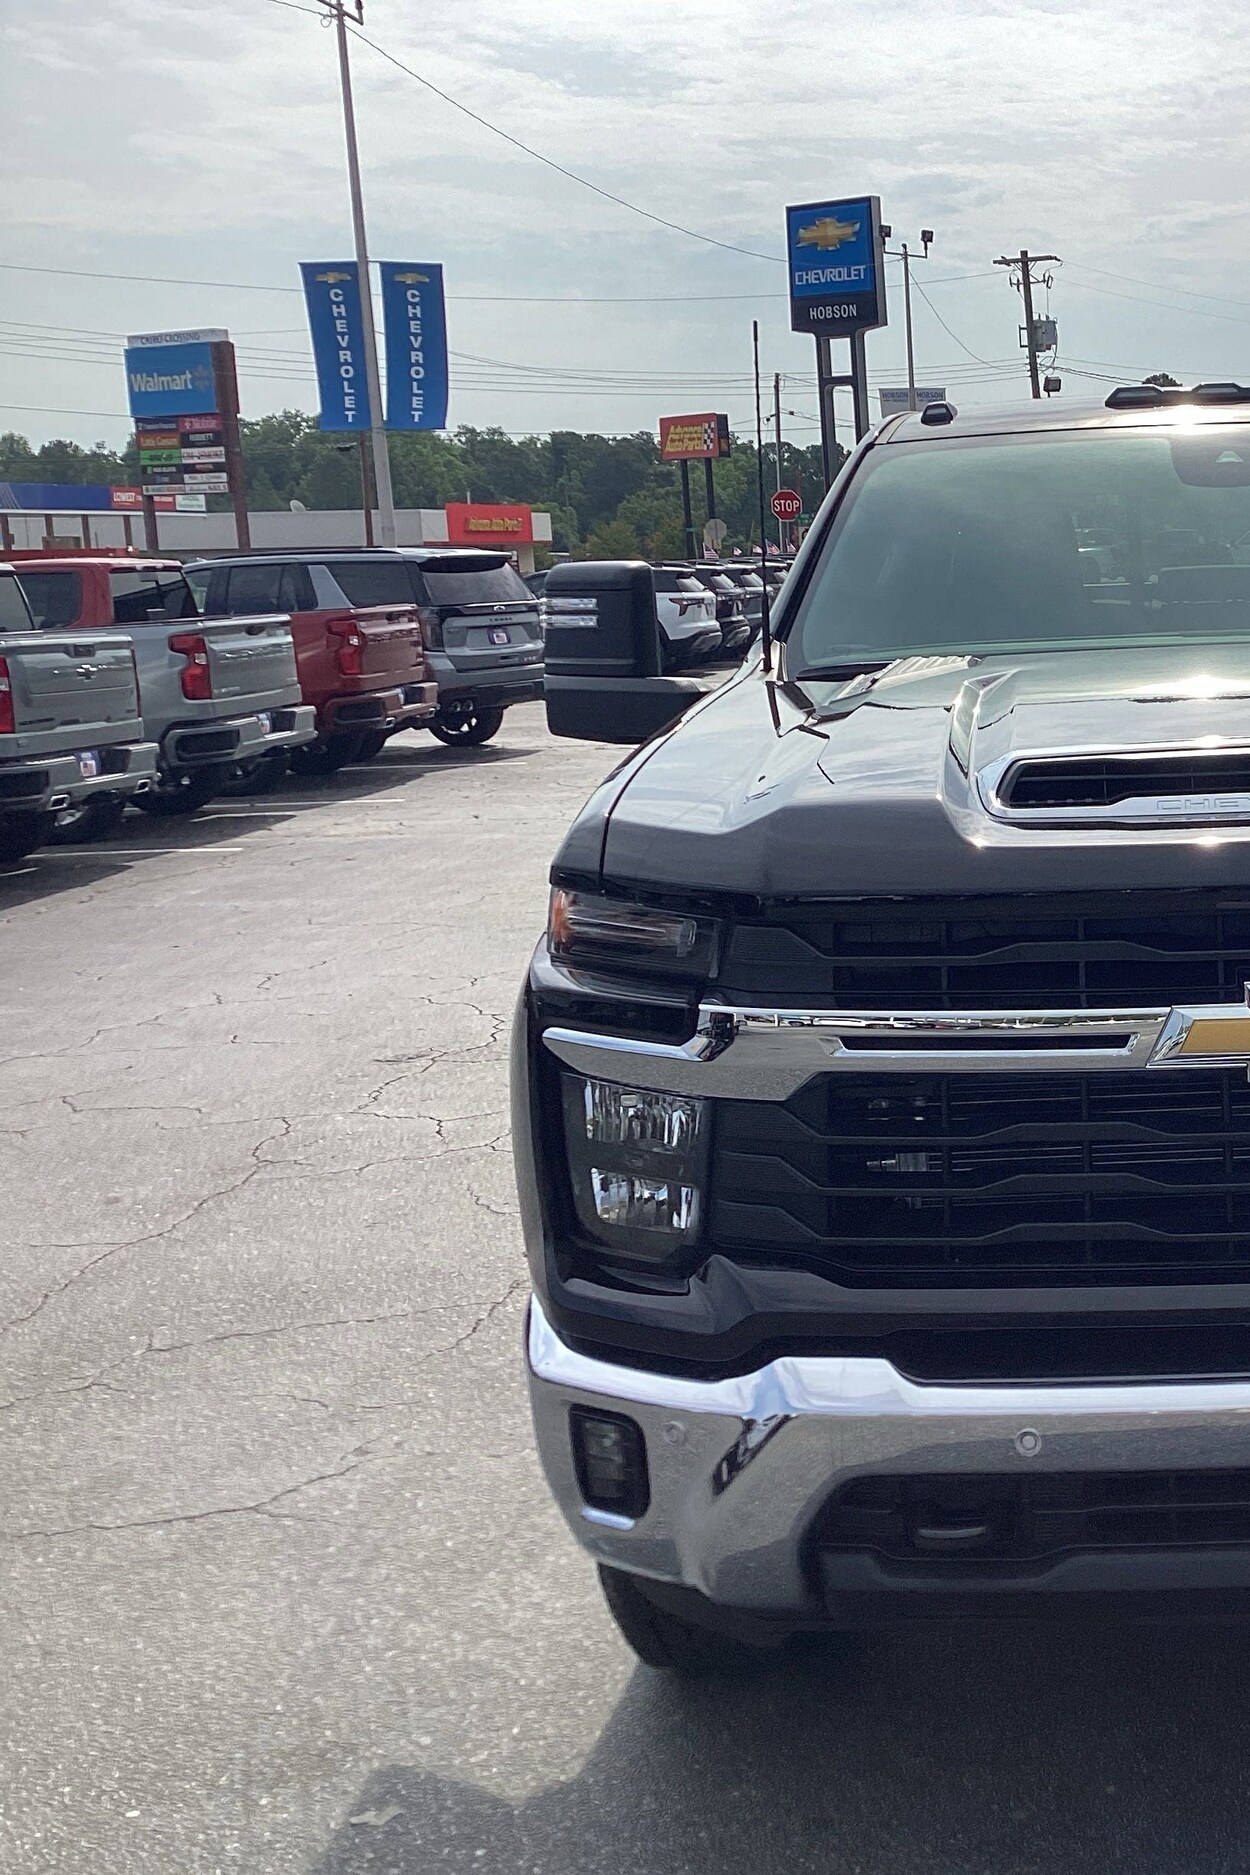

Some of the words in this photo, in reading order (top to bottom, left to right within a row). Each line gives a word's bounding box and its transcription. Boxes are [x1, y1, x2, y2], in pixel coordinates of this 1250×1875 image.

[795, 265, 866, 285] CHEVROLET
[809, 303, 857, 320] HOBSON
[329, 288, 356, 423] CHEVROLET
[406, 289, 425, 423] CHEVROLET
[130, 369, 193, 392] Walmart
[882, 391, 909, 399] HOBSON
[667, 424, 704, 439] Advance
[664, 440, 683, 453] Auto
[682, 439, 704, 452] Parts
[773, 499, 800, 512] STOP
